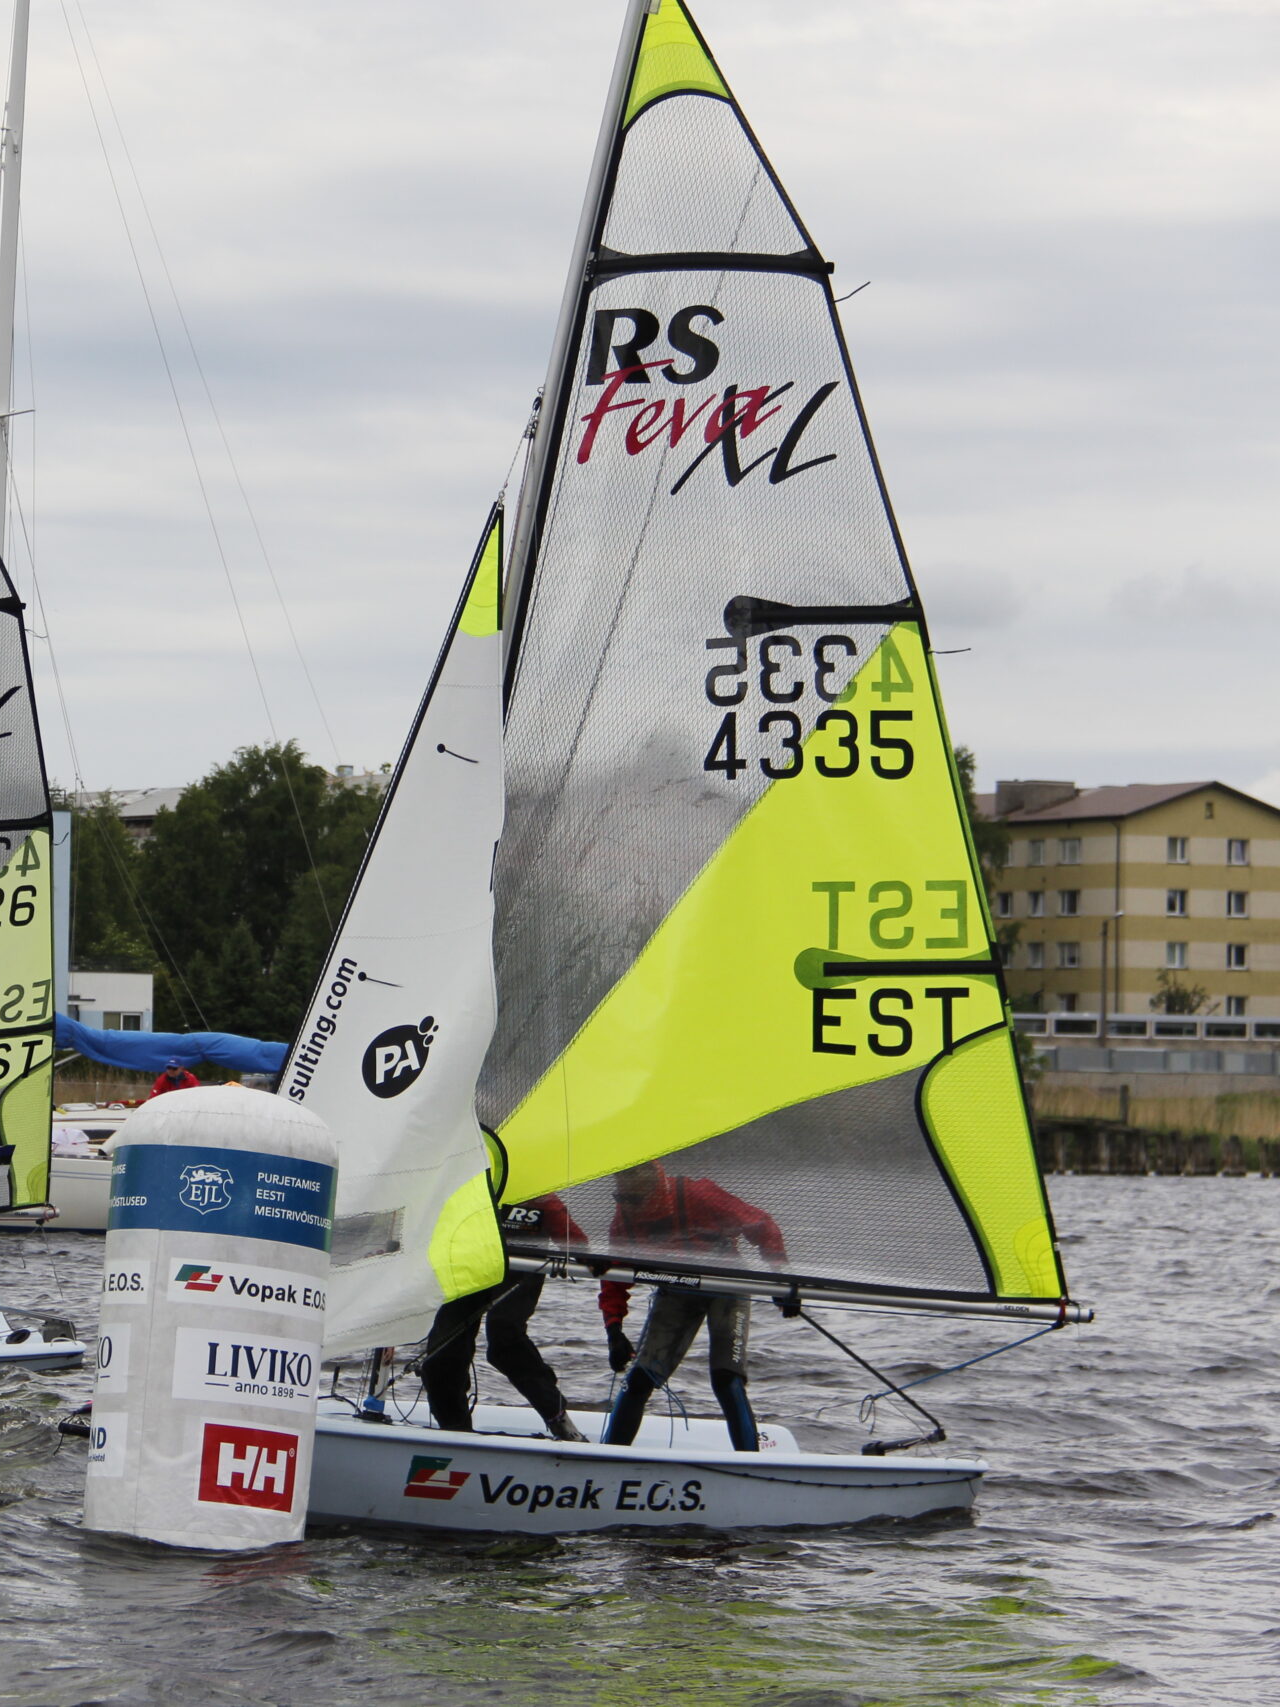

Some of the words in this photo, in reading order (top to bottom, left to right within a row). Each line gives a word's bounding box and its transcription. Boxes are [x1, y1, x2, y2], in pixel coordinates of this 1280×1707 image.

[585, 304, 725, 386] RS
[576, 358, 783, 464] Feva
[703, 709, 914, 780] 4335
[812, 987, 970, 1057] EST
[375, 1040, 421, 1085] PA
[190, 1184, 223, 1206] EJL
[255, 1188, 285, 1203] EESTI
[257, 1172, 321, 1193] PURJETAMISE
[507, 1207, 541, 1223] RS
[108, 1272, 144, 1292] E.O.S.
[229, 1275, 297, 1304] Vopak
[206, 1342, 312, 1387] LIVIKO
[235, 1381, 268, 1395] anno
[272, 1386, 295, 1398] 1898
[479, 1473, 604, 1514] Vopak
[615, 1479, 706, 1513] E.O.S.
